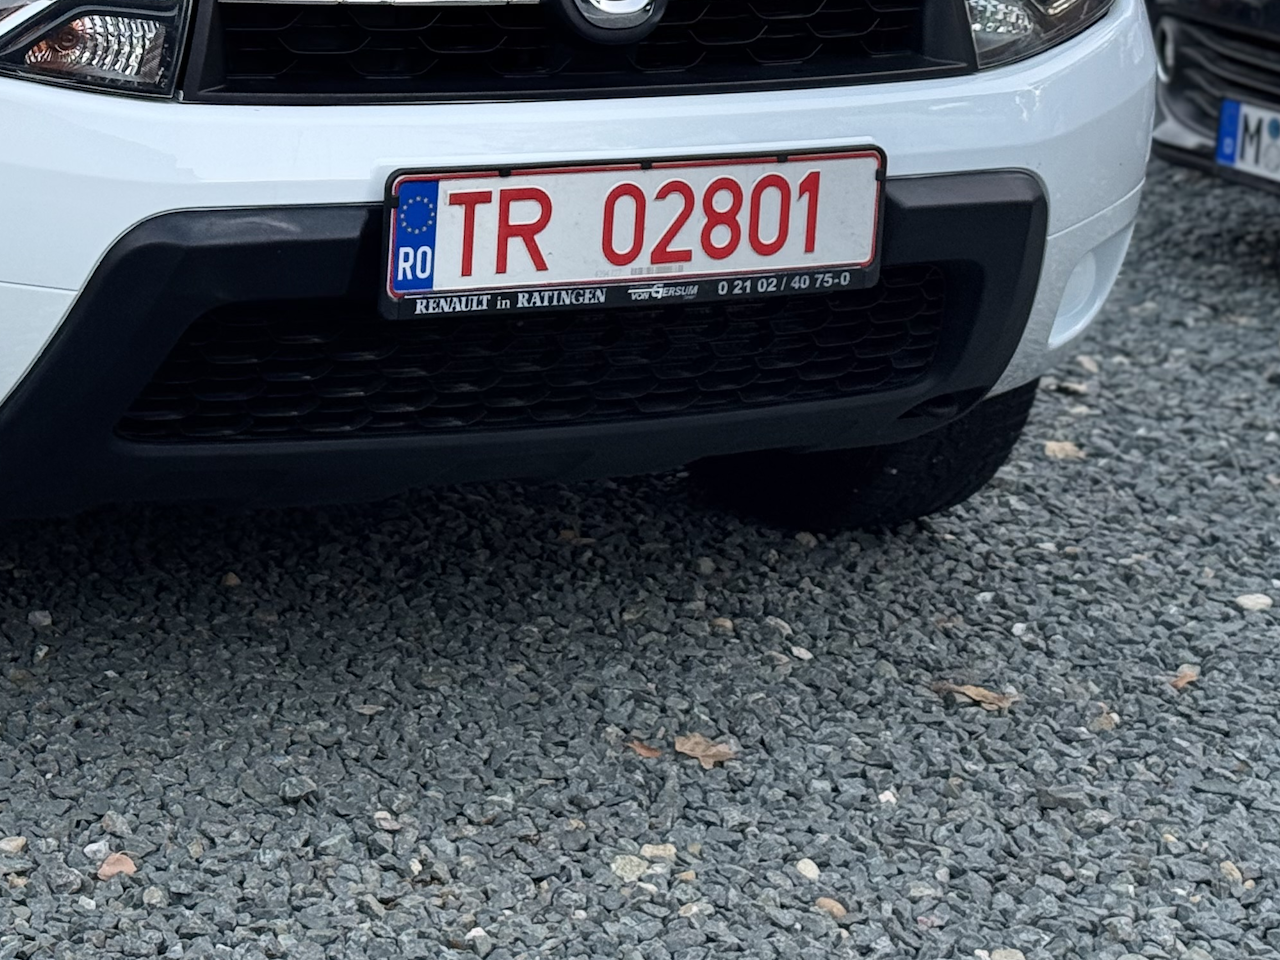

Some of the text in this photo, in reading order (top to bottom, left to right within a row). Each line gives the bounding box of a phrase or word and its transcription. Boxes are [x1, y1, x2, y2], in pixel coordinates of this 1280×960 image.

[1239, 113, 1263, 166] M
[448, 171, 821, 277] TR 02801
[397, 245, 432, 281] RO
[415, 288, 607, 314] RENAULT in RATINGEN
[718, 281, 729, 295] 0
[732, 279, 751, 294] 21
[757, 277, 778, 292] 02
[790, 275, 810, 289] 40
[814, 271, 851, 288] 75-0
